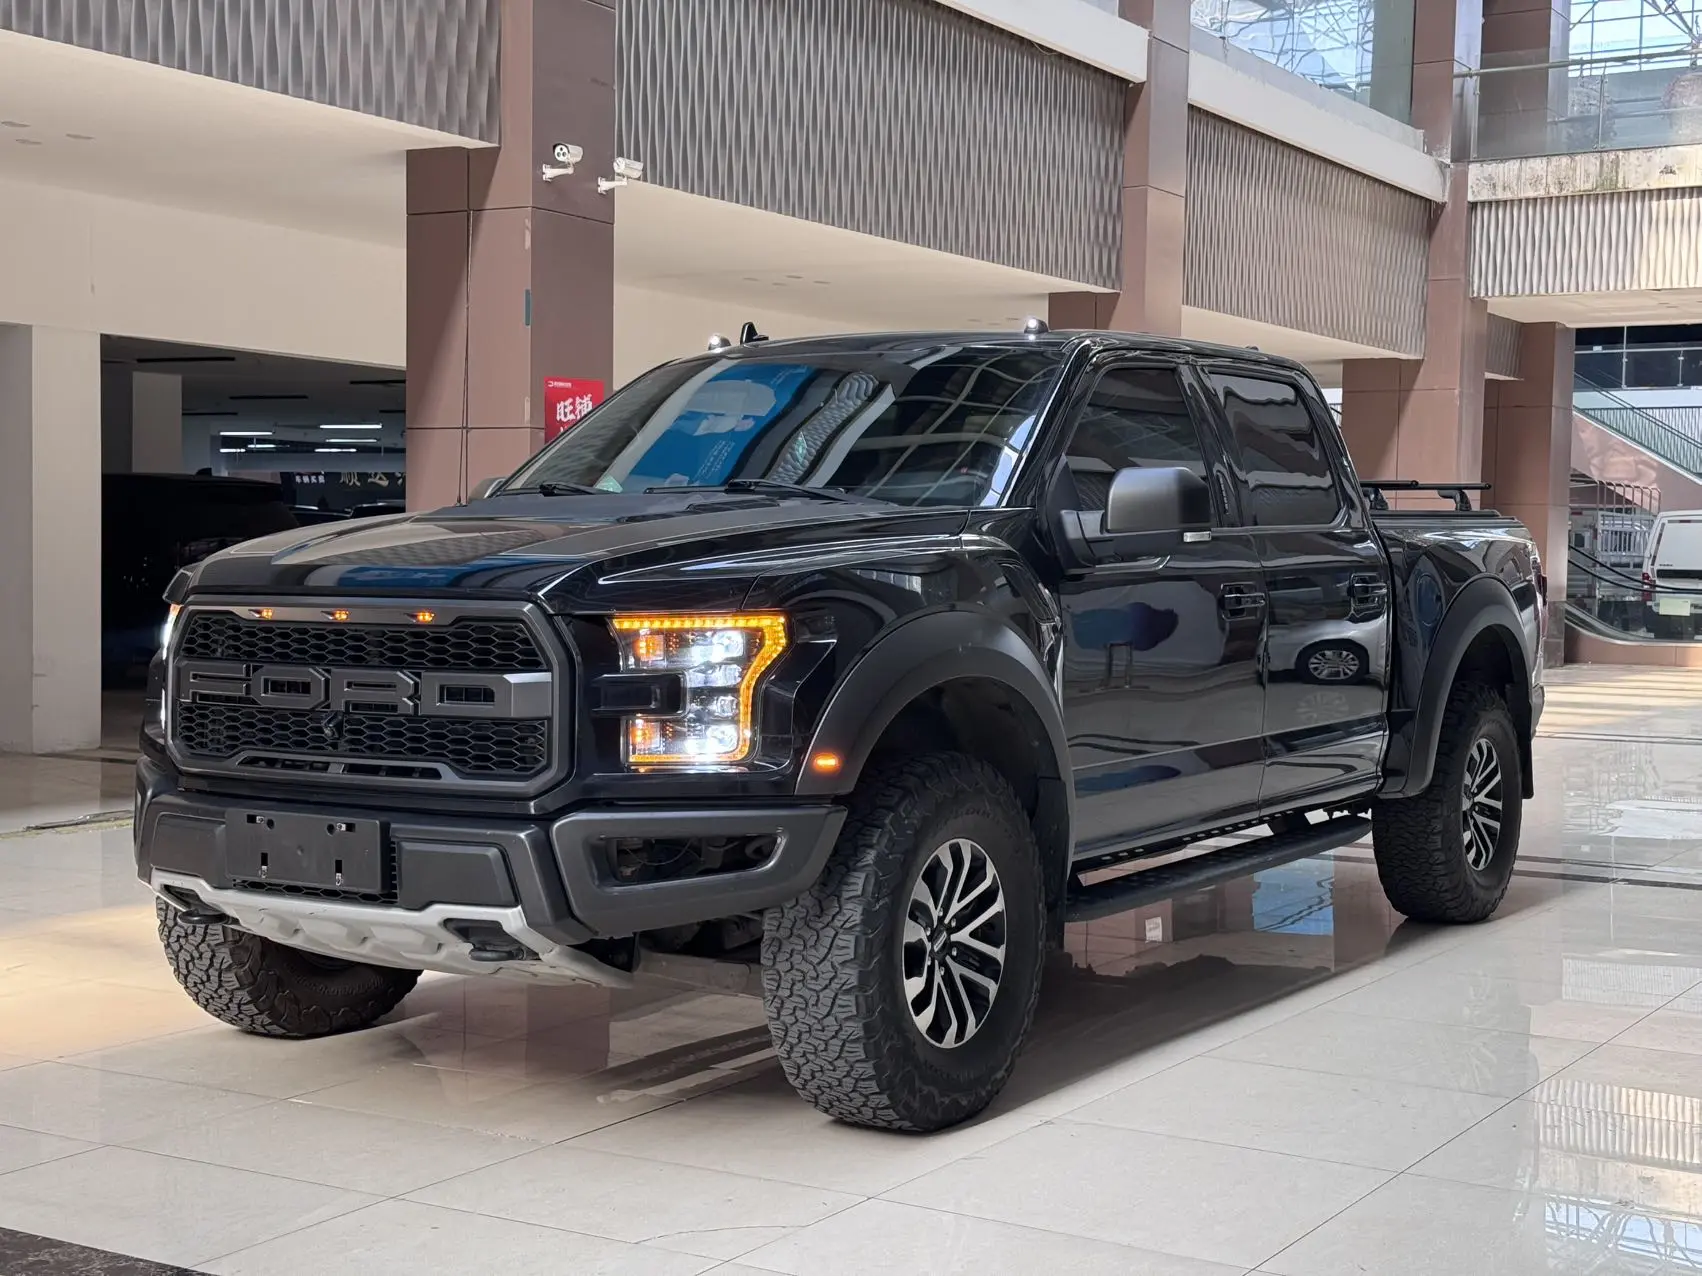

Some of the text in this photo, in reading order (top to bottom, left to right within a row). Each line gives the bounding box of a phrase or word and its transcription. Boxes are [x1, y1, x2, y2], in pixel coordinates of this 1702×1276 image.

[555, 393, 593, 422] 旺铺
[339, 471, 406, 487] 顺达
[176, 660, 514, 718] FORD
